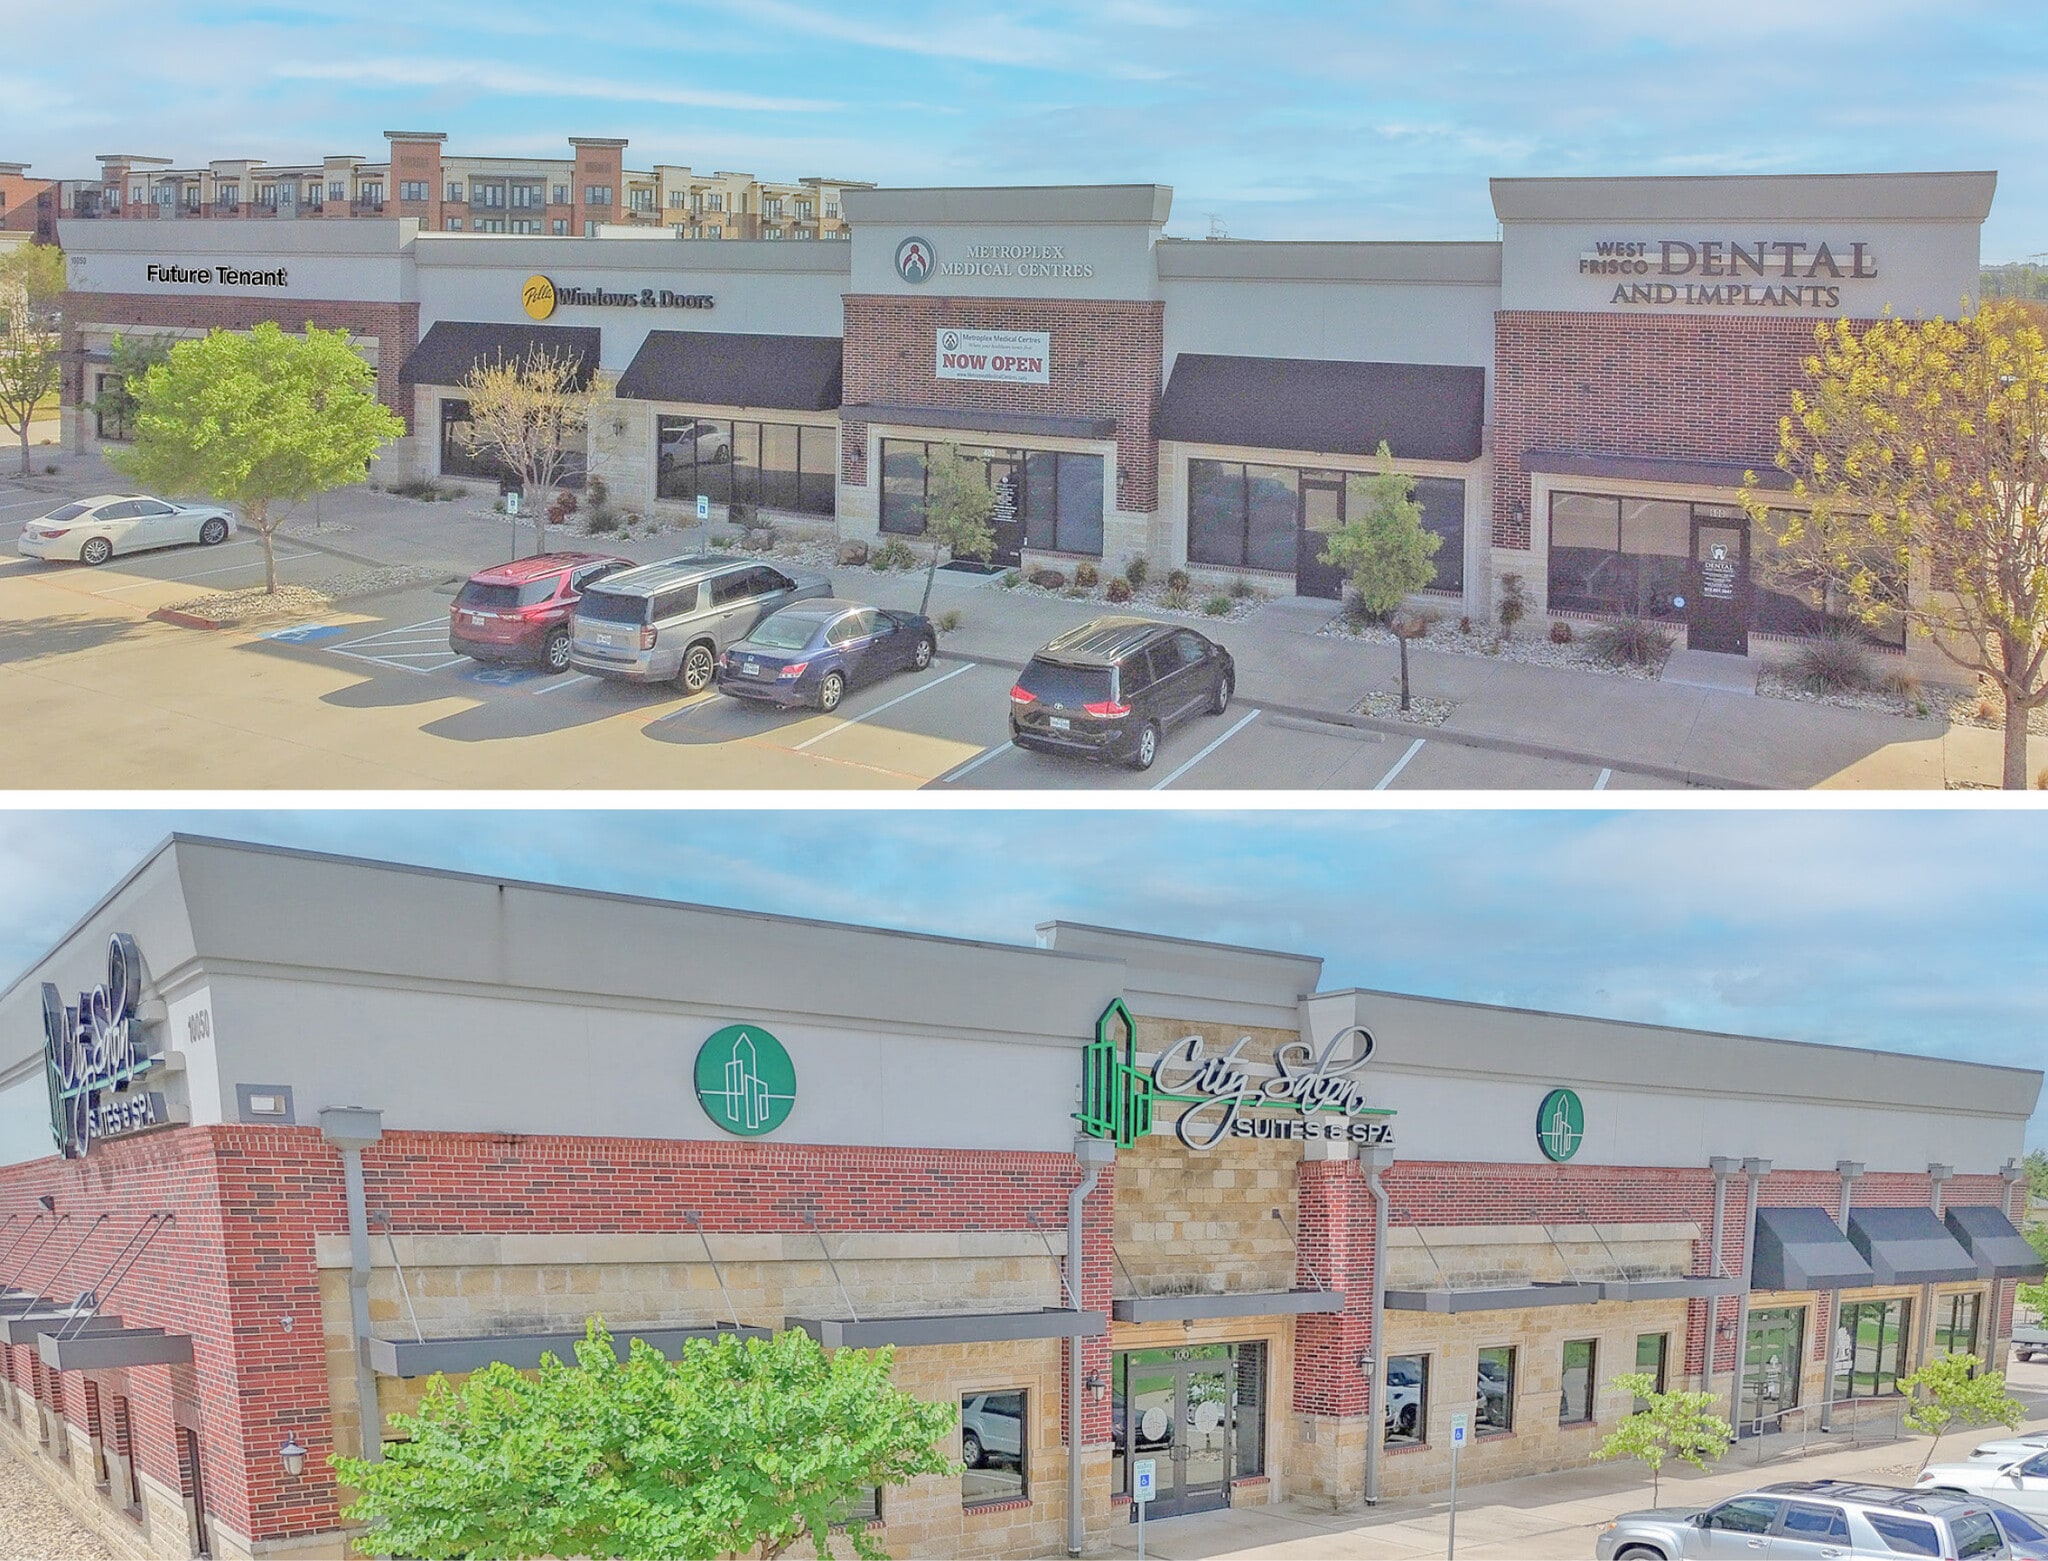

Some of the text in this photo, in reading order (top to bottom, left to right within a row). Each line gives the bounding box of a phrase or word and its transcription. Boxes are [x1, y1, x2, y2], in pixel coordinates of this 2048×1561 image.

[966, 245, 1066, 260] METROPLEX
[1595, 241, 1647, 257] WEST
[1657, 240, 1879, 279] DENTAL
[147, 263, 288, 287] Future Tenant
[940, 262, 1095, 279] MEDICAL CENTRES
[1579, 258, 1649, 275] FRISCO
[523, 284, 554, 309] Pella
[558, 287, 715, 310] Windows & Doors
[1609, 282, 1841, 309] AND IMPLANTS
[942, 353, 1043, 373] NOW OPEN
[187, 1008, 210, 1044] 10050
[1153, 1025, 1377, 1151] City Salon
[1234, 1117, 1398, 1144] SUITES & SPA
[1173, 1350, 1190, 1361] 100
